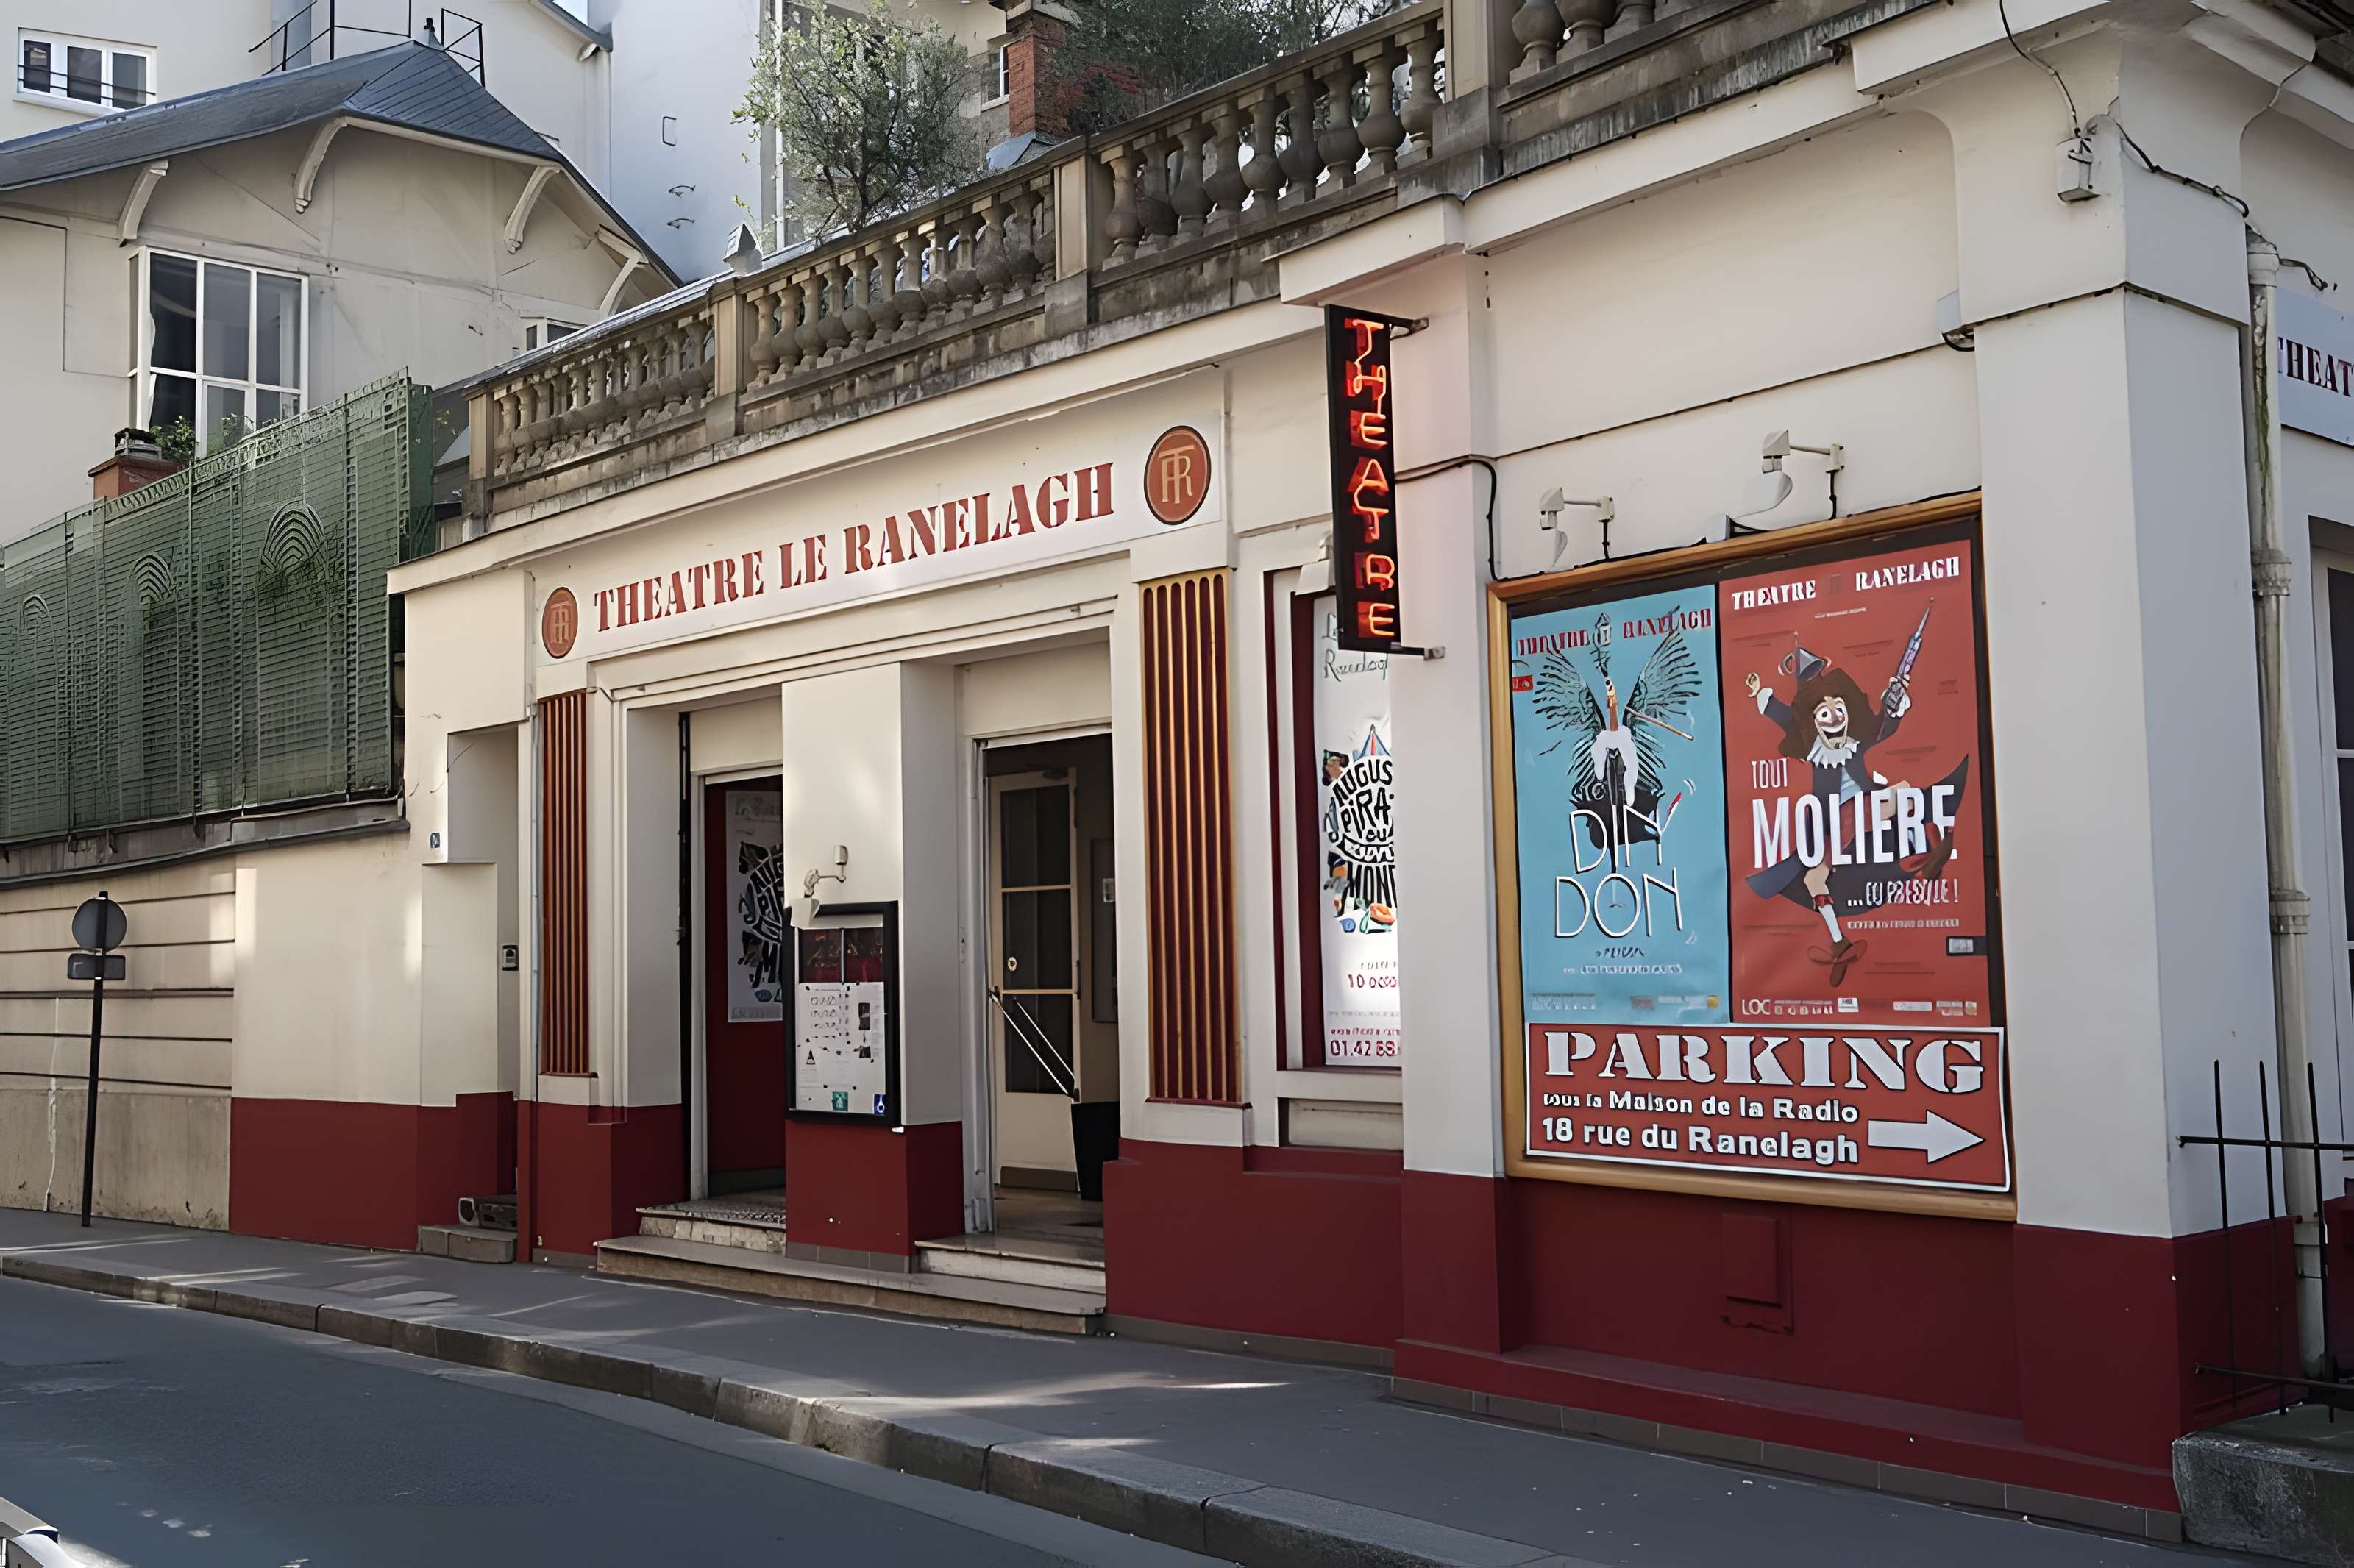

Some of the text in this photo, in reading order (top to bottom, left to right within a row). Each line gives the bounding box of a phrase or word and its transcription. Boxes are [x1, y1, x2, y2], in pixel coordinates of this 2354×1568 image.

[2278, 336, 2354, 398] HEAT
[1344, 318, 1395, 638] THEATRE
[594, 461, 1114, 632] THEATRE LE RANELAGH
[1752, 758, 1788, 788] TOUT
[1543, 1030, 1985, 1095] PARKING
[1609, 1090, 1693, 1113] Maison
[1702, 1095, 1730, 1116] de
[1740, 1096, 1763, 1118] la
[1773, 1097, 1859, 1123] Radio
[1542, 1116, 1859, 1166] 18 rue du Ranelagh
